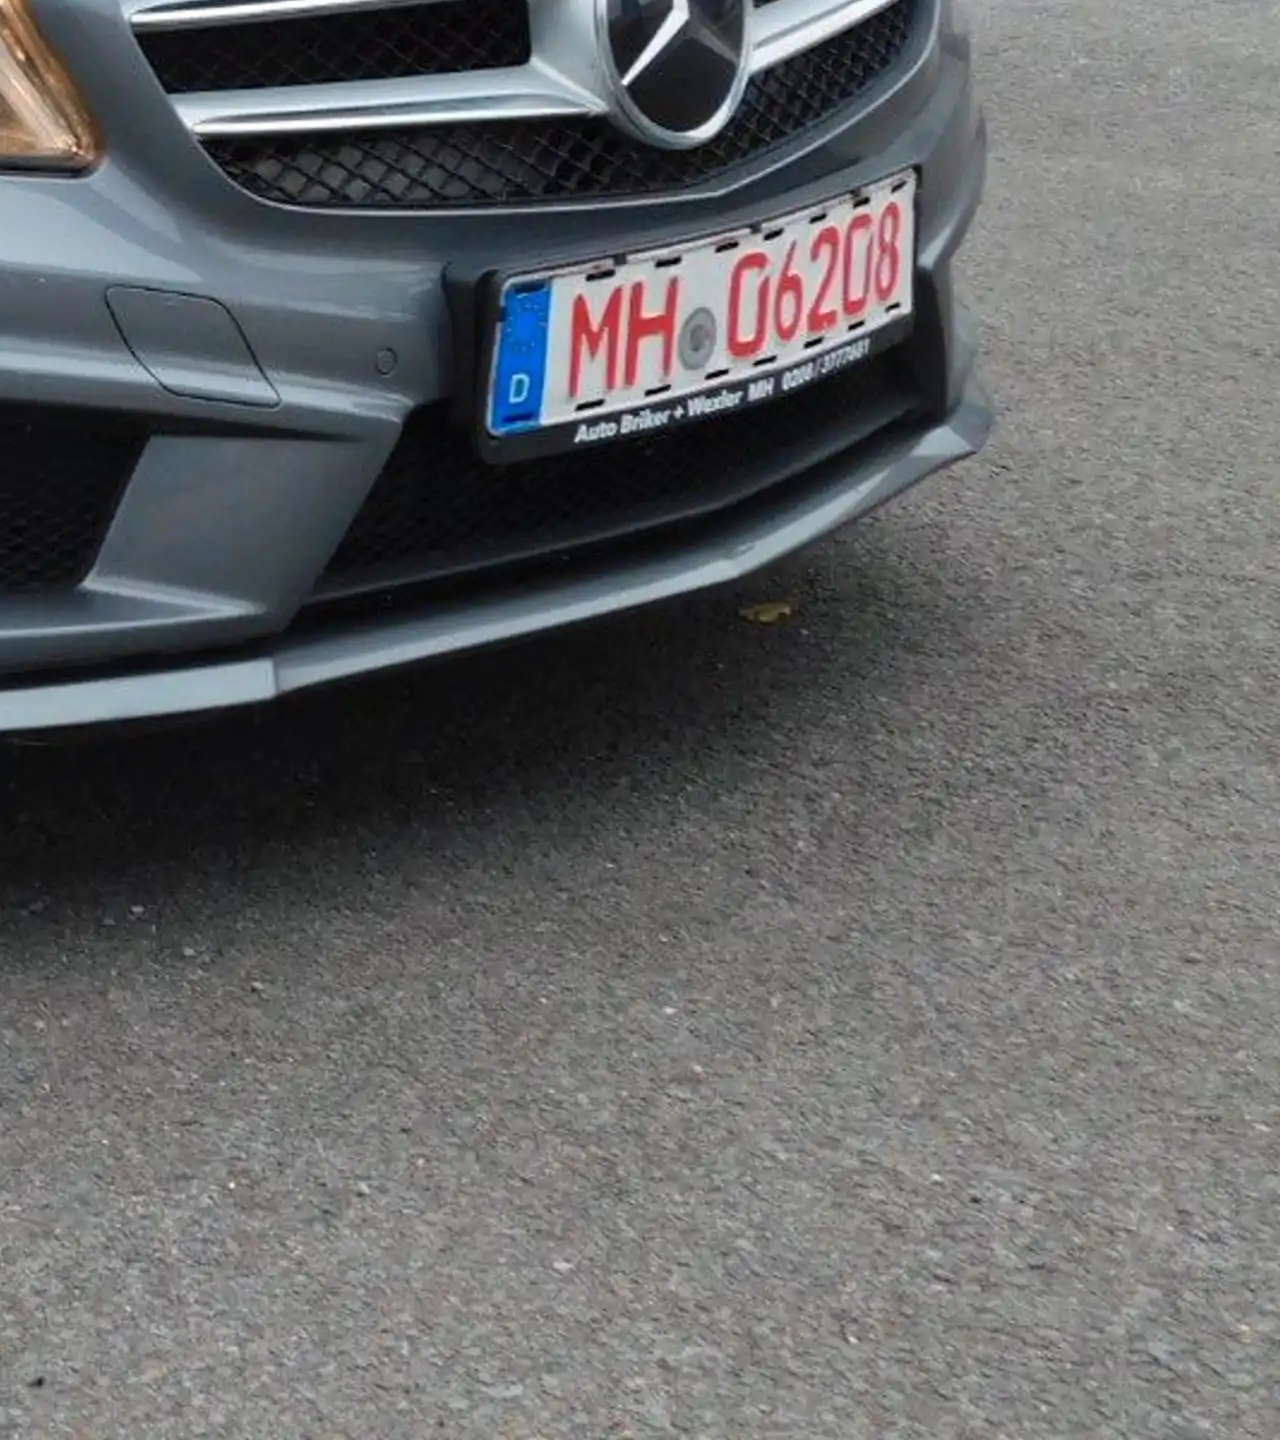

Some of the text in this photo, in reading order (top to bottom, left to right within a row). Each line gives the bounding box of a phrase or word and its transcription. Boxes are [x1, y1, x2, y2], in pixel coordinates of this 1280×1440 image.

[569, 201, 901, 398] MH 06208
[509, 373, 531, 404] D
[574, 422, 618, 443] Auto
